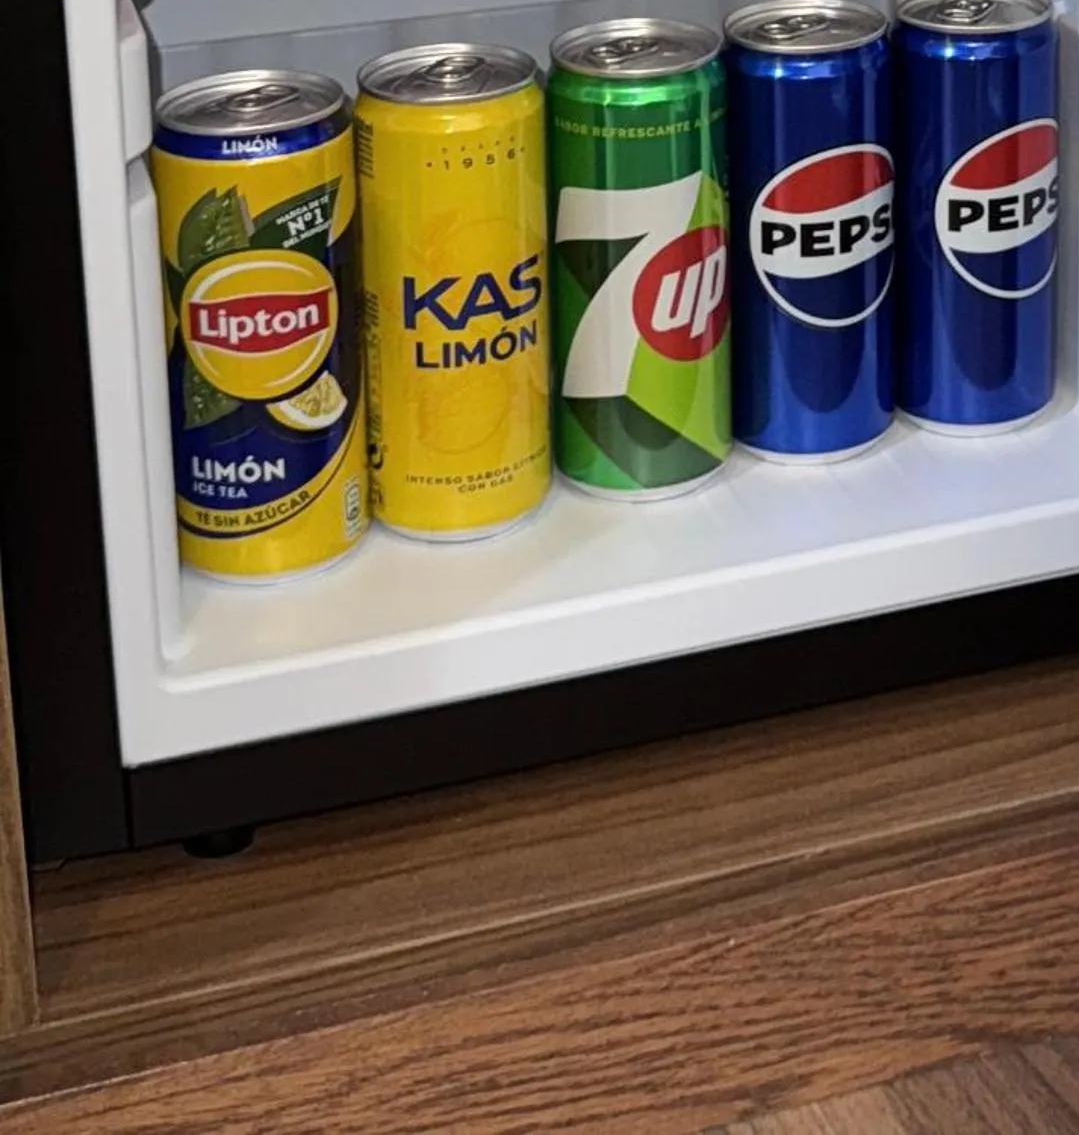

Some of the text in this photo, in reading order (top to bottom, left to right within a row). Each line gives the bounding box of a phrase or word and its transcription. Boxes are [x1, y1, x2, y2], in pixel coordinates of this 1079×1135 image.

[221, 133, 278, 155] LIMÓN
[592, 120, 691, 139] REFRESCANTE
[947, 175, 1061, 233] PEPS
[760, 203, 891, 258] PEPS
[402, 253, 541, 333] KAS
[197, 300, 320, 347] Lipton
[415, 321, 538, 370] LIMÓN
[192, 455, 286, 483] LIMÓN
[193, 480, 249, 499] ICE TEA
[213, 515, 241, 527] SIN
[244, 489, 312, 526] AZÚCAR
